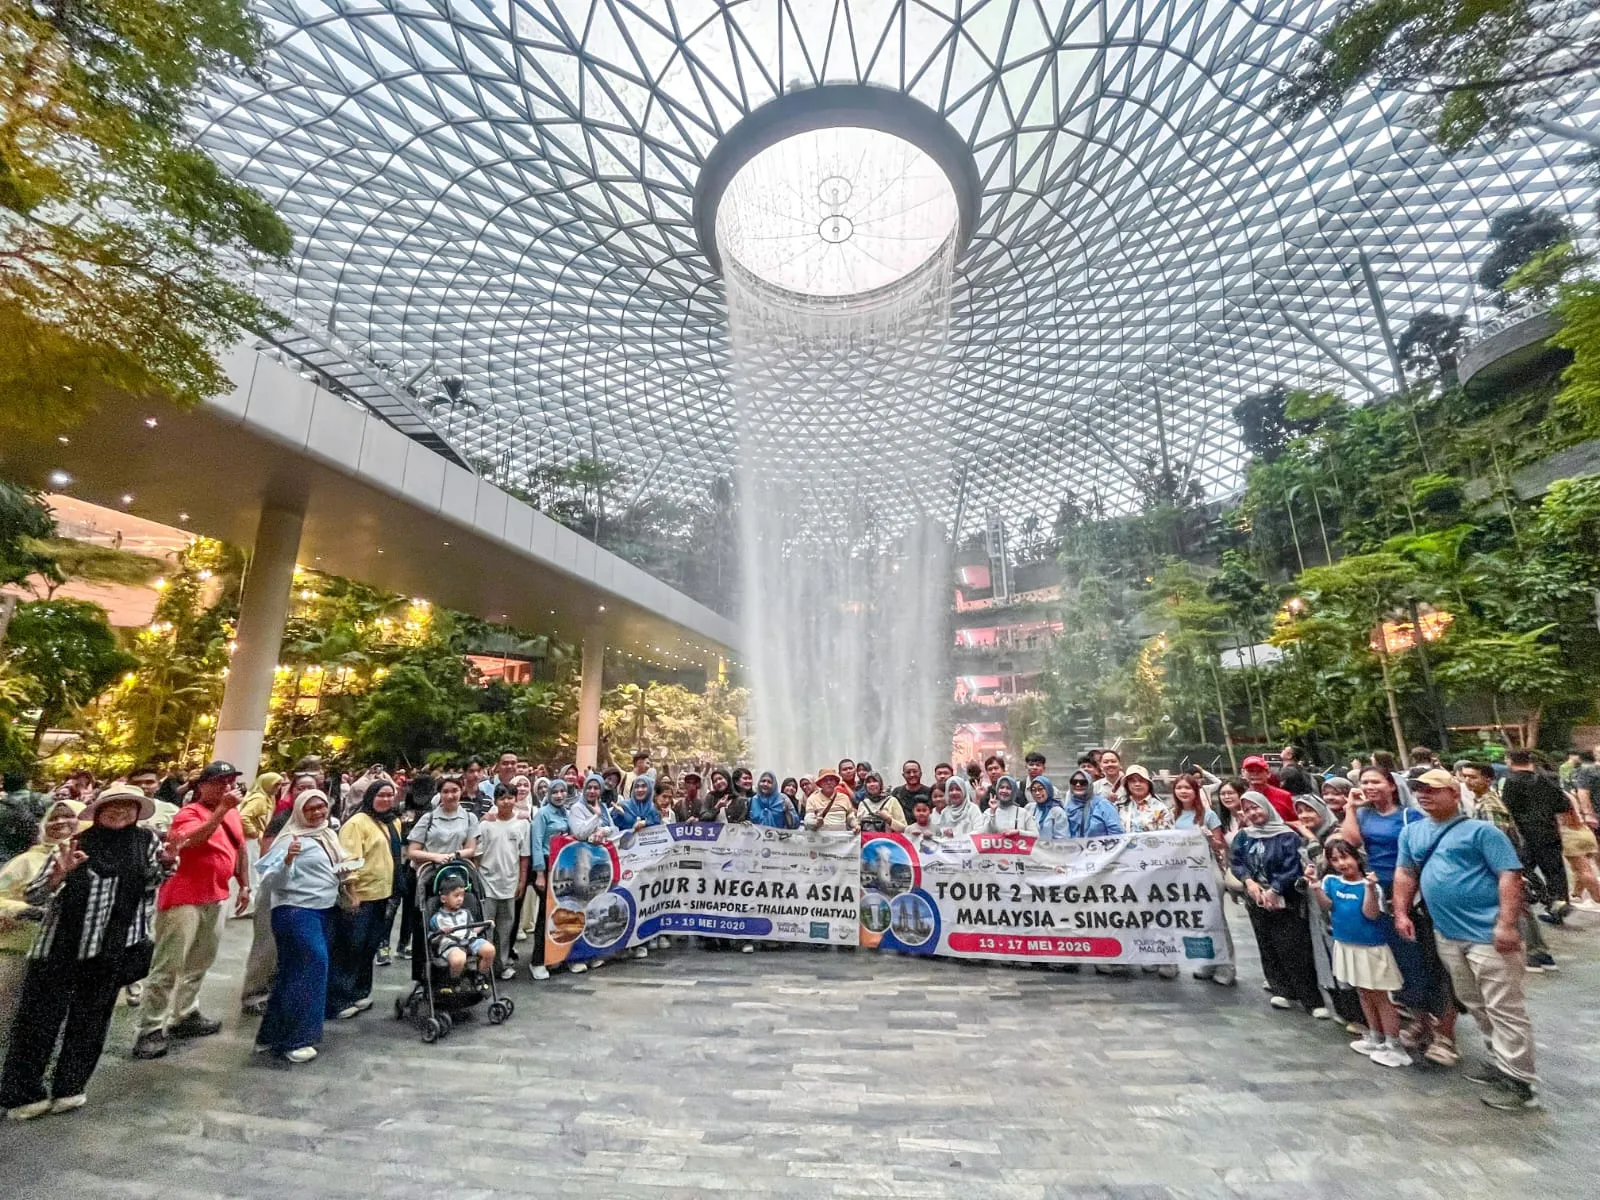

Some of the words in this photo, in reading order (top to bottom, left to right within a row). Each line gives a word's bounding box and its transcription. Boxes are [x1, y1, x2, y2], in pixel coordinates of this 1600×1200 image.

[676, 826, 703, 837] BUS
[707, 828, 715, 837] 1
[981, 838, 1012, 849] BUS
[1018, 839, 1027, 850] 2
[639, 877, 690, 902] TOUR
[696, 877, 706, 894] 3
[713, 879, 799, 899] NEGARA
[806, 883, 855, 903] ASIA
[936, 882, 1002, 902] TOUR
[1010, 884, 1022, 902] 2
[1030, 884, 1138, 903] NEGARA
[1147, 882, 1213, 903] ASIA
[639, 899, 681, 919] MALAYSIA
[690, 900, 748, 913] SINGAPORE
[757, 904, 809, 916] THAILAND
[810, 907, 857, 920] (HATYAI)
[660, 918, 672, 926] 13
[698, 918, 717, 928] MEI
[956, 908, 1055, 927] MALAYSIA
[1074, 909, 1205, 928] SINGAPORE
[980, 939, 995, 948] 13
[1008, 940, 1023, 950] 17
[1027, 940, 1052, 951] MEI
[1057, 942, 1091, 952] 2026
